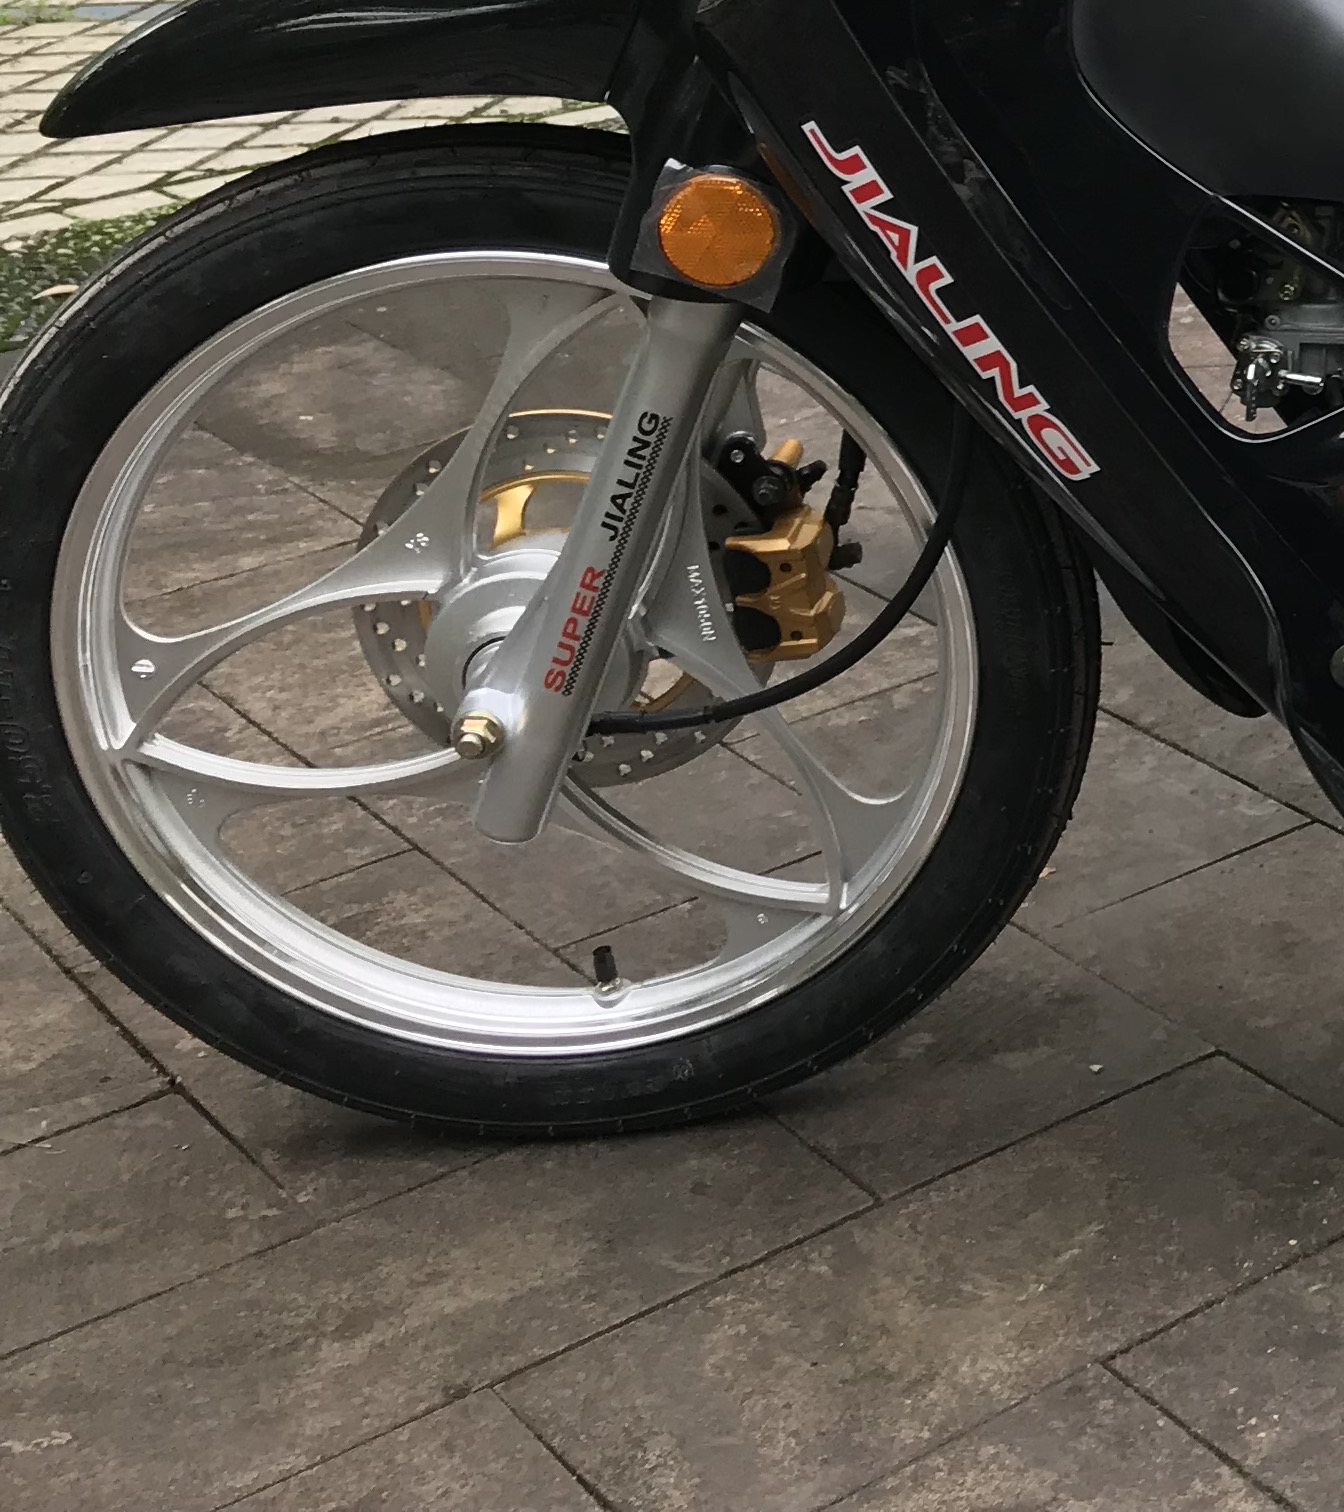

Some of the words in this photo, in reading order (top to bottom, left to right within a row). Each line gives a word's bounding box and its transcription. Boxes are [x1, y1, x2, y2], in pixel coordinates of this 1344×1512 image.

[801, 120, 1101, 481] JIALING
[543, 565, 606, 693] SUPER
[600, 410, 661, 542] JIALING
